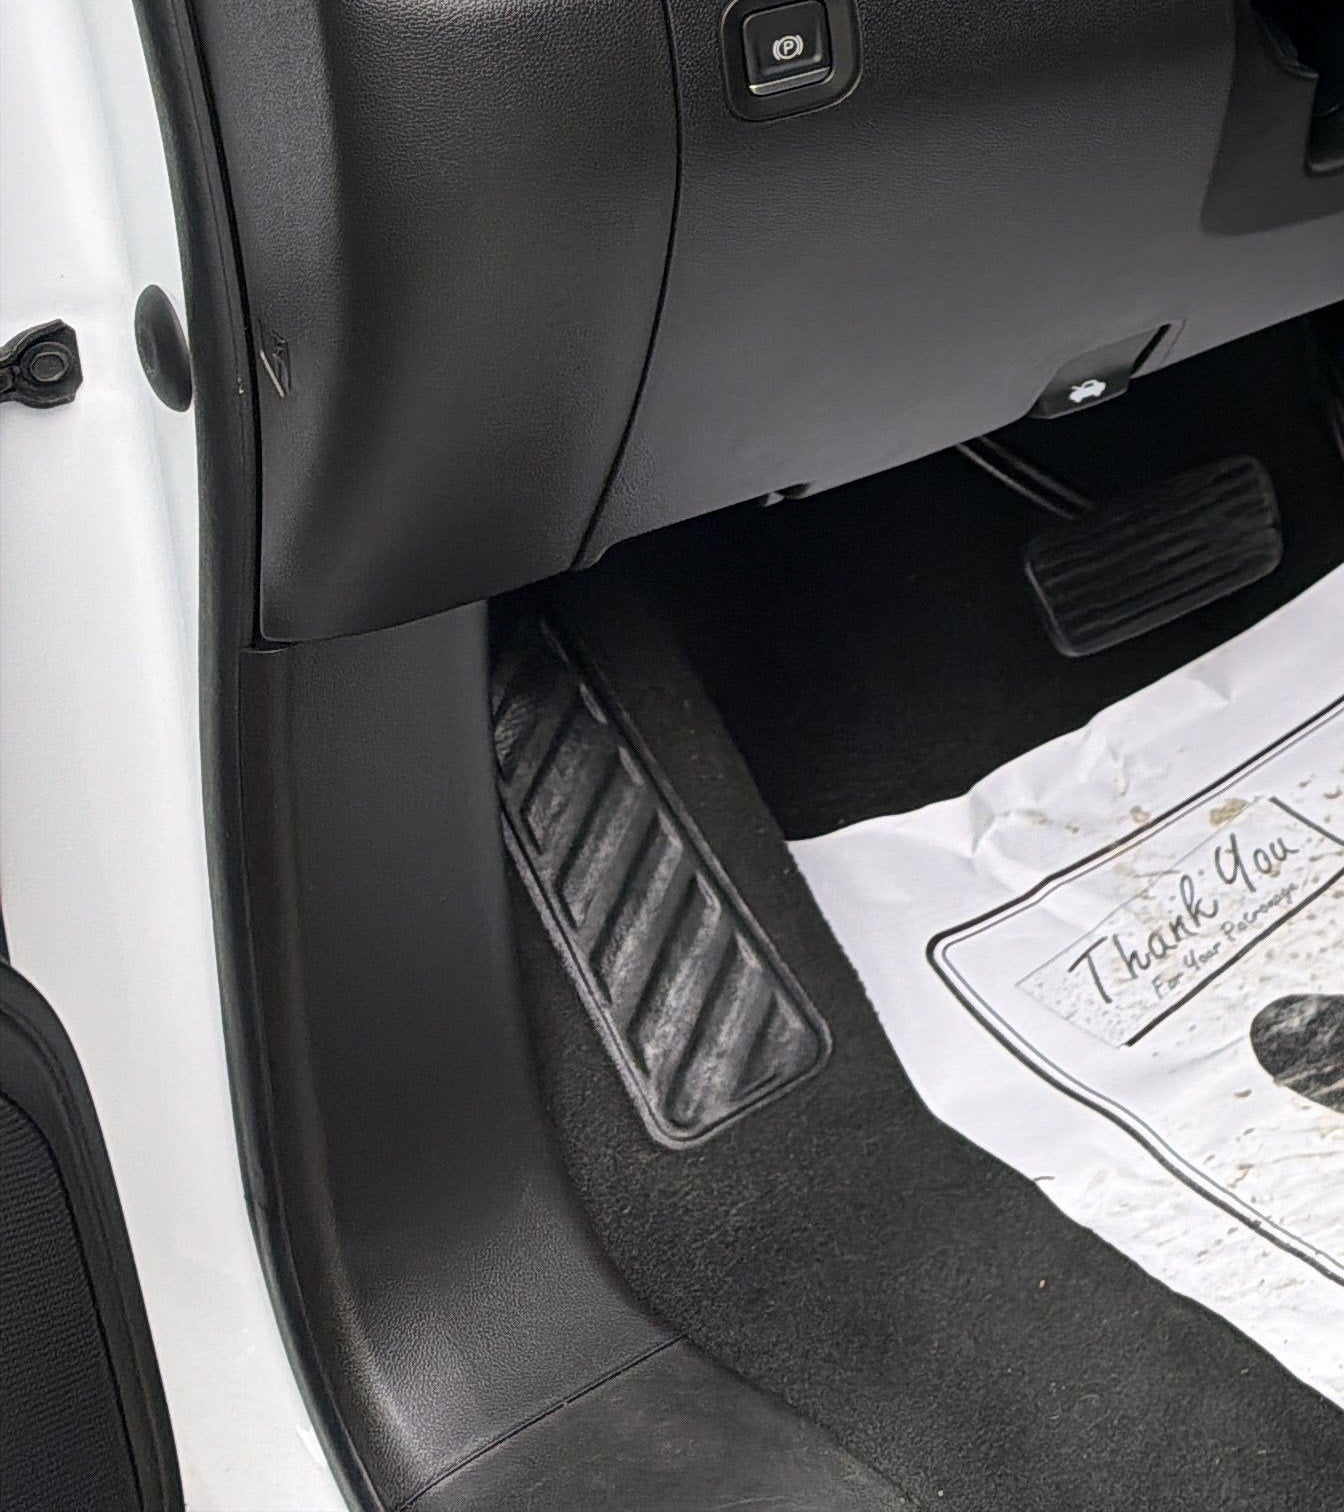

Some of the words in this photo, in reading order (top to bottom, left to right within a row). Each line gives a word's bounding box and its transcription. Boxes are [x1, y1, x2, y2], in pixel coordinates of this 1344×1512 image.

[1067, 875, 1218, 1004] Thank
[1214, 832, 1299, 893] You
[1151, 972, 1184, 1000] For
[1183, 941, 1222, 971] Your
